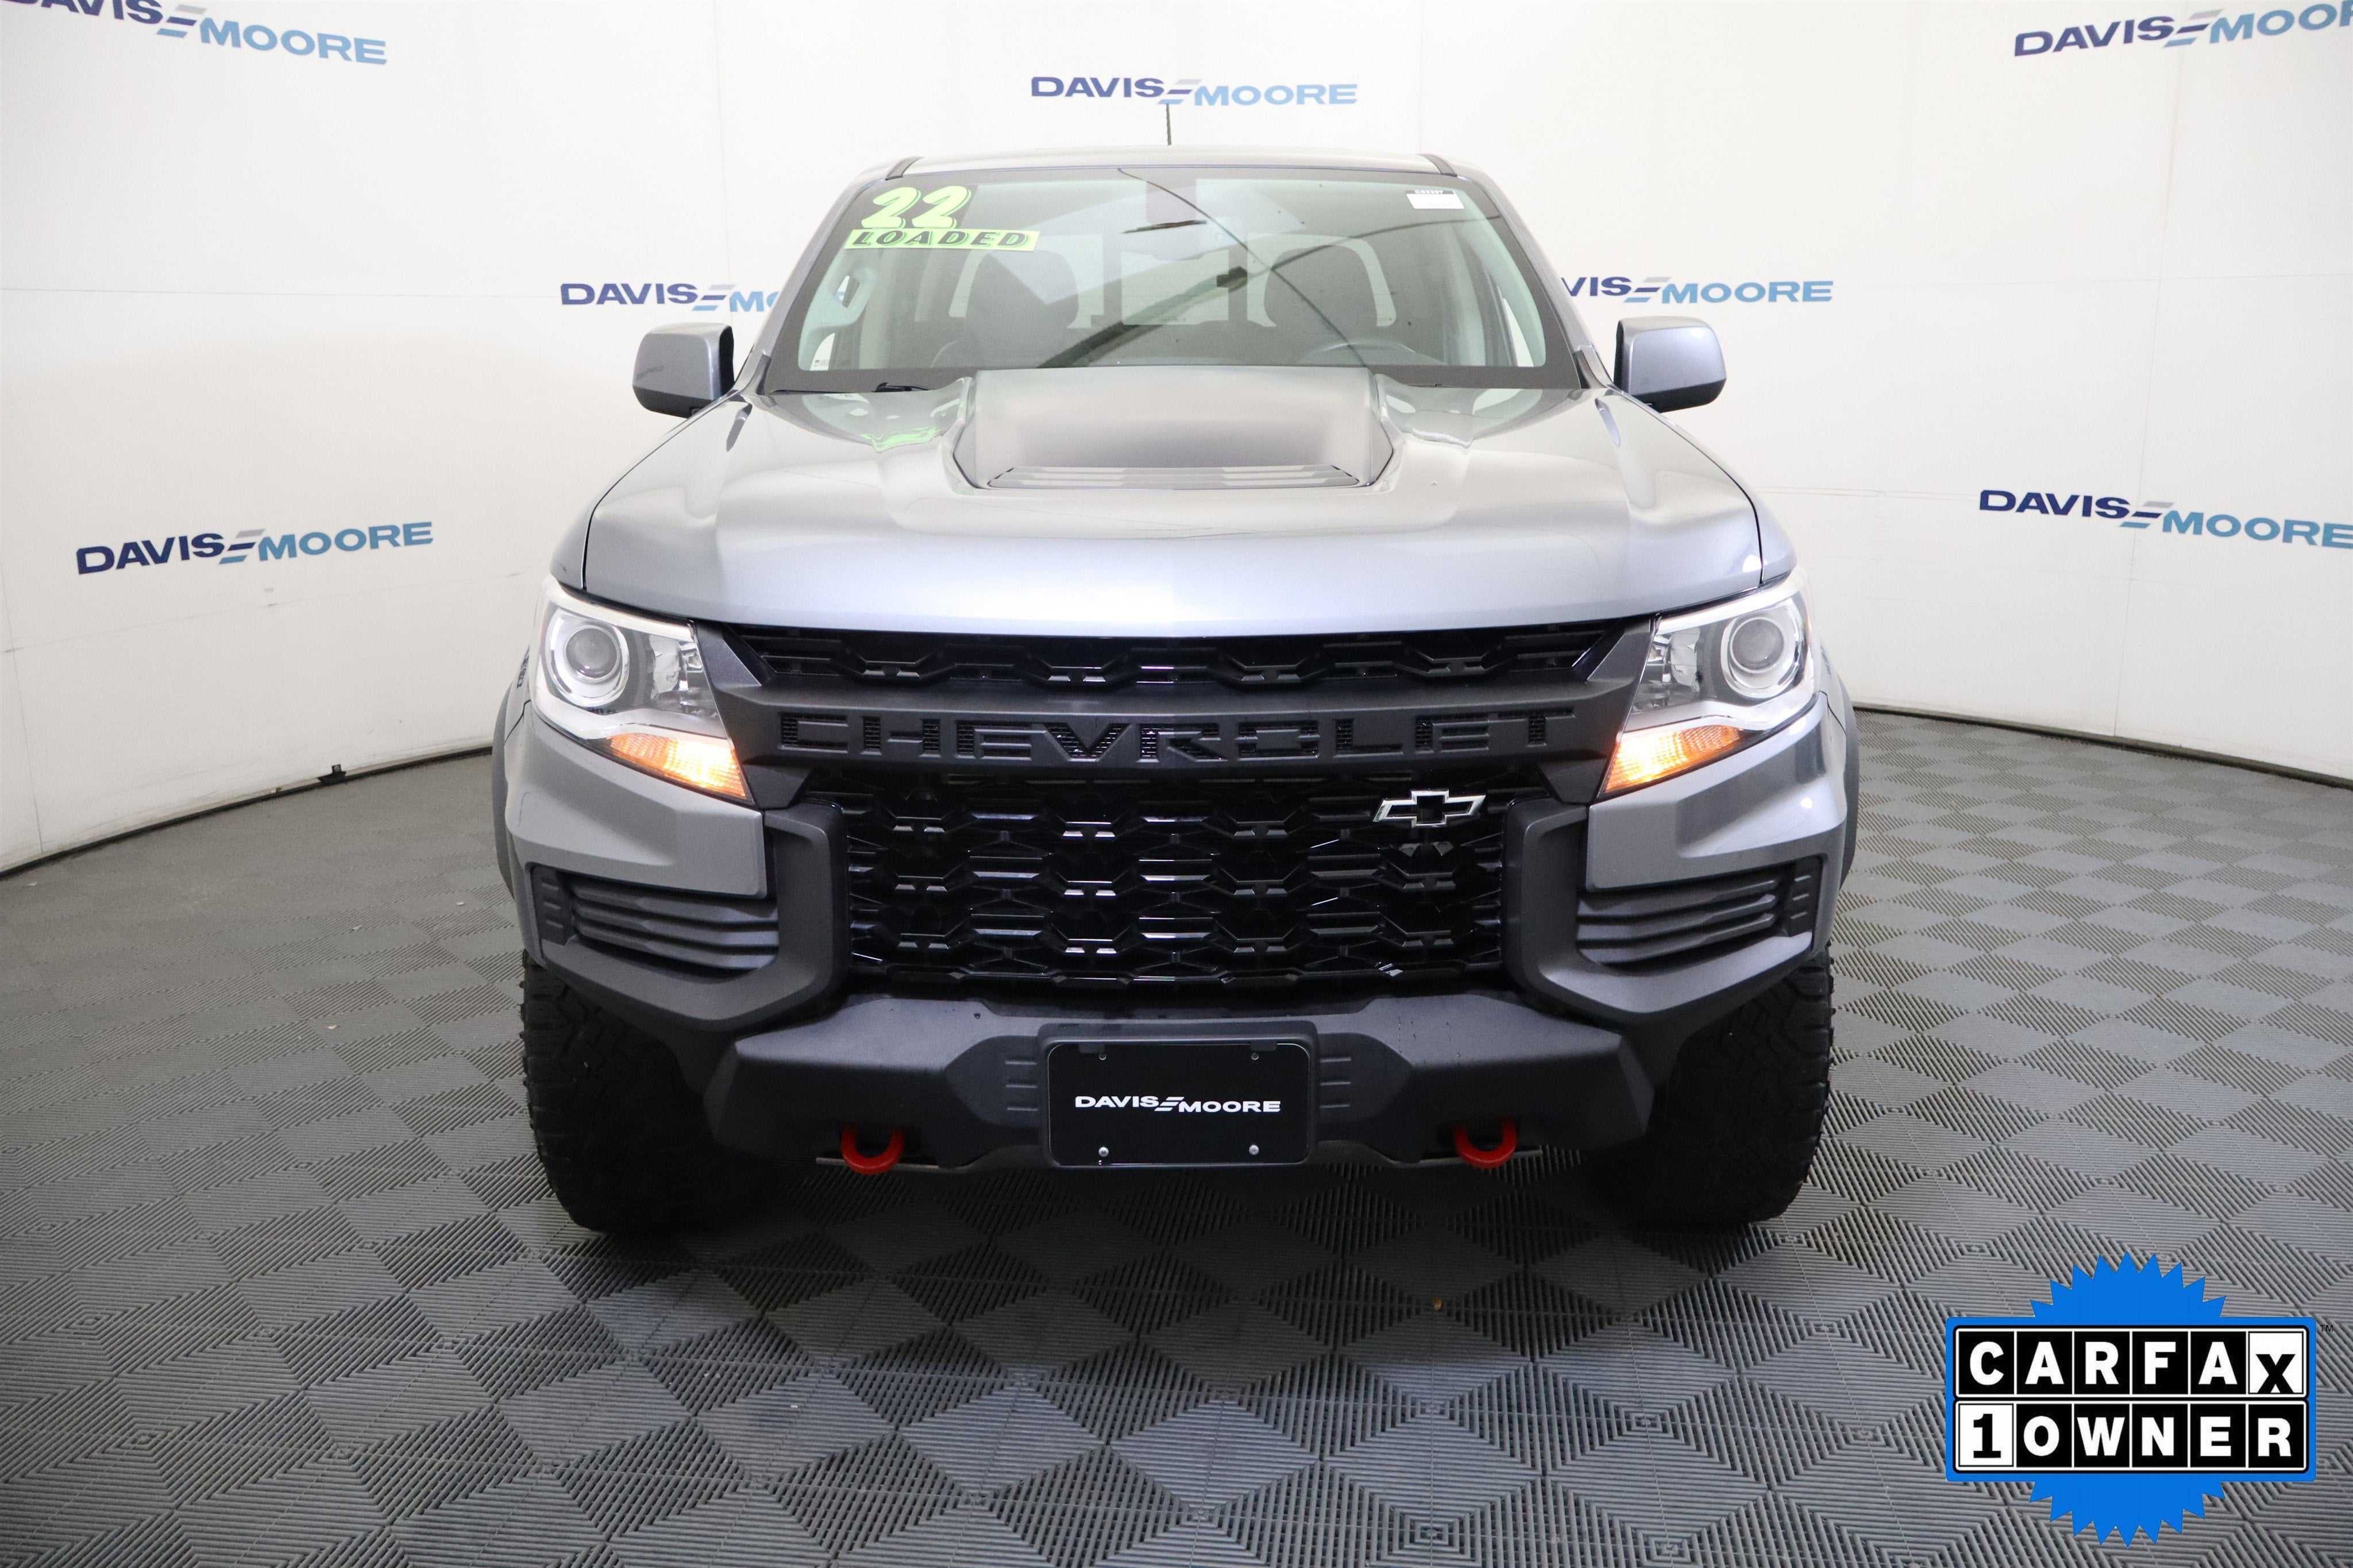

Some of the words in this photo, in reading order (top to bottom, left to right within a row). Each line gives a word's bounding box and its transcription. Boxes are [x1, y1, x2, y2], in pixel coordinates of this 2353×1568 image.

[2, 0, 163, 24] VIS
[200, 18, 387, 65] MOORE
[2015, 17, 2173, 56] DAVIS
[2210, 0, 2353, 43] MOO
[1032, 77, 1164, 97] DAVIS
[1195, 84, 1357, 106] MOORE
[861, 185, 971, 229] 22
[852, 230, 1028, 248] LOADED
[561, 283, 698, 305] DAVIS
[1561, 277, 1631, 296] VIS
[1662, 281, 1834, 304] MOORE
[1980, 490, 2130, 519] DAVIS
[2163, 510, 2353, 549] MOORE
[76, 533, 225, 574] DAVIS
[259, 522, 433, 561] MOORE
[779, 706, 1575, 763] CHEVROLET
[1075, 1095, 1159, 1108] DAVIS
[1178, 1100, 1281, 1113] MOORE
